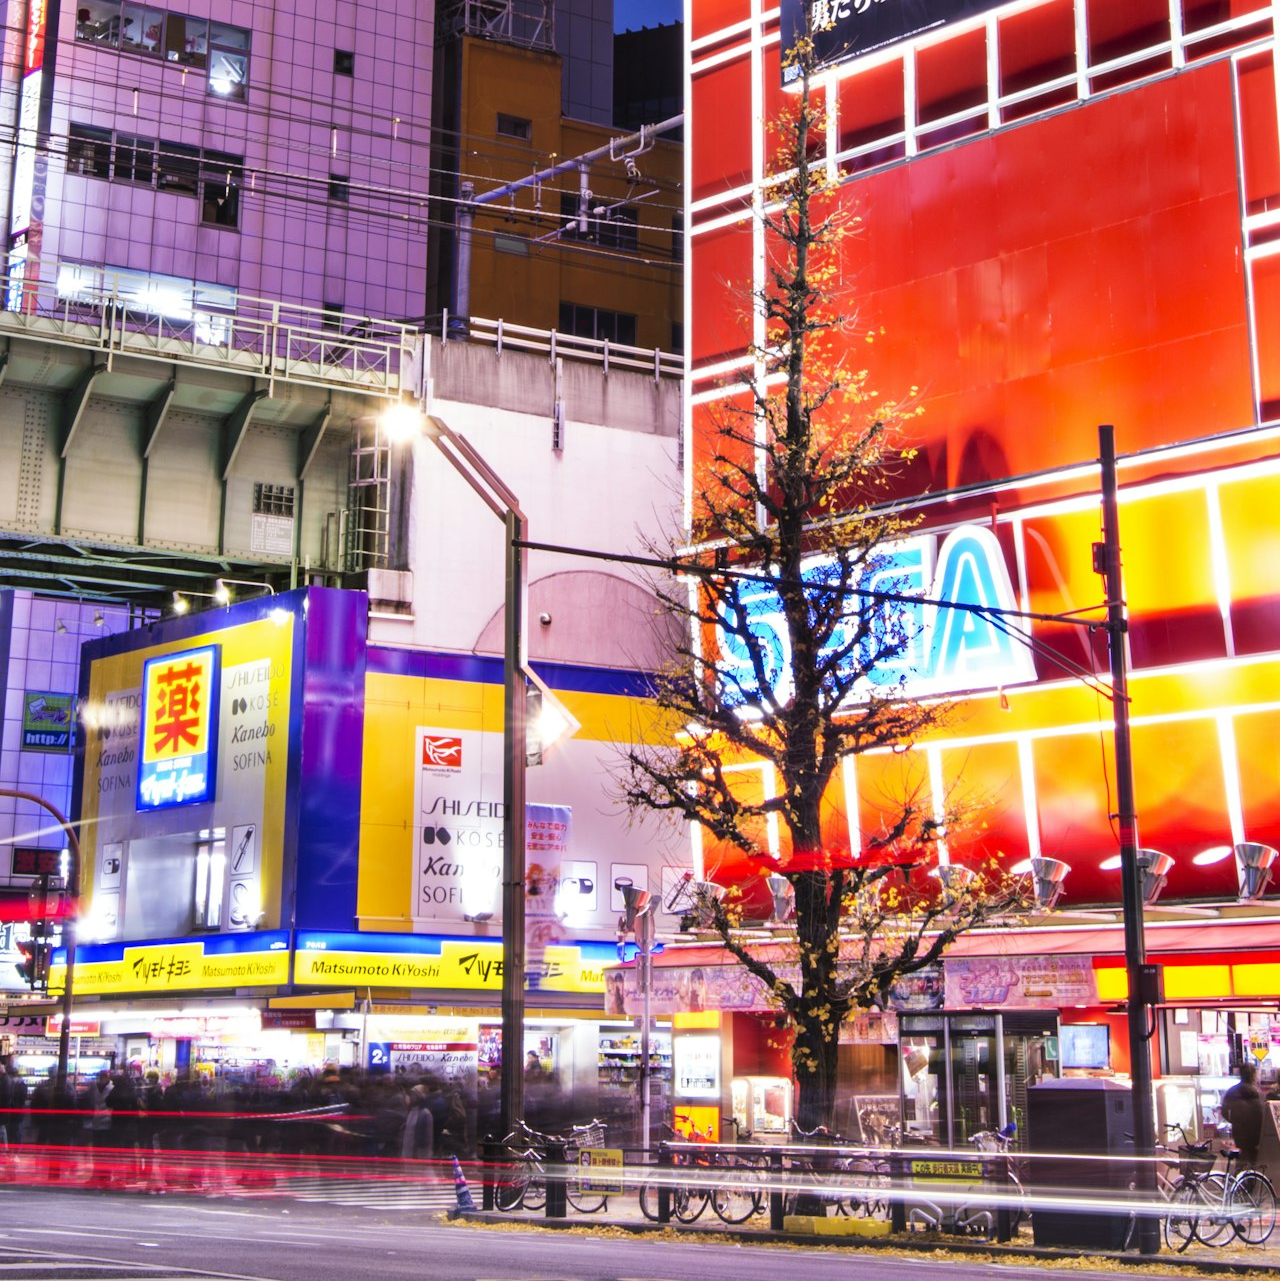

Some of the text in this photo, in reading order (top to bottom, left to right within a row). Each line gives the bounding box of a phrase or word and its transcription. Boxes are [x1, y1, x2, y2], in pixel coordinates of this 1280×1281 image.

[226, 661, 285, 690] SHISEIDO
[153, 661, 204, 755] 薬
[231, 719, 276, 744] Kanebo
[96, 746, 135, 768] Kanebo
[233, 751, 272, 772] SOFINA
[96, 776, 131, 794] SOFINA
[422, 796, 507, 819] SHISEID
[201, 960, 276, 979] Matsumoto KiYoshi
[311, 960, 441, 979] Matsumoto KiYoshi
[395, 1052, 474, 1064] SHISEIDO Kanebo
